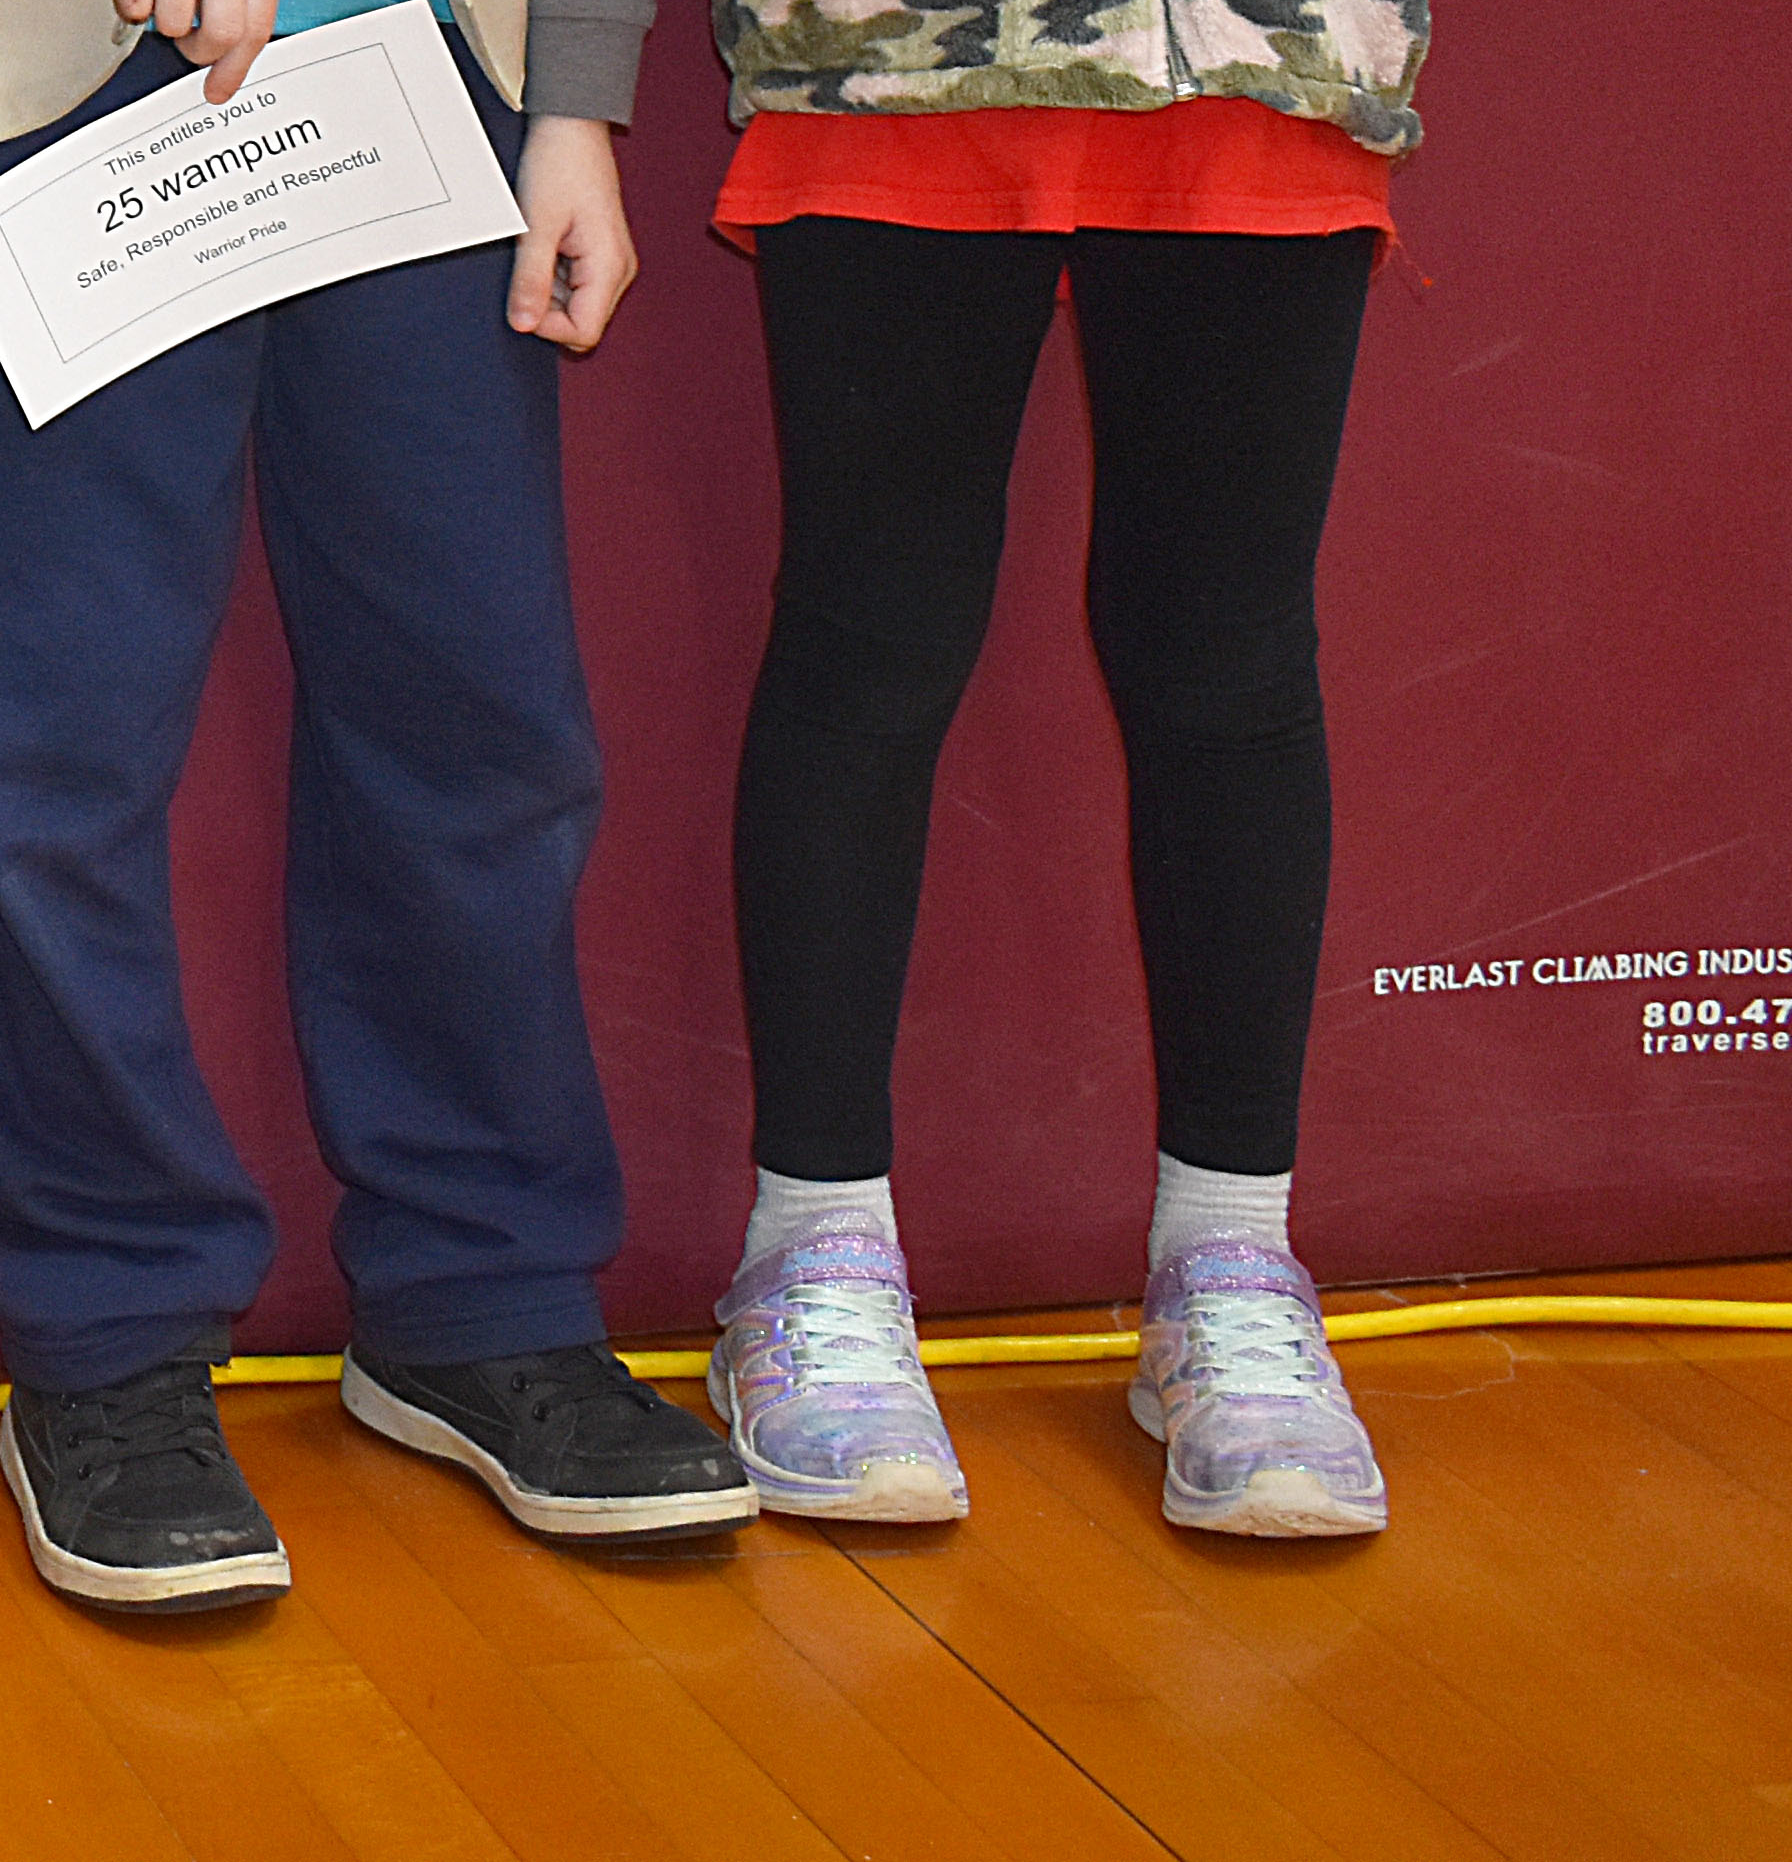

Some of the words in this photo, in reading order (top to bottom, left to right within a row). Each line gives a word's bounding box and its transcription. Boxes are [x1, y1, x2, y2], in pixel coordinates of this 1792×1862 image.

[104, 149, 147, 178] This
[149, 113, 215, 158] entitles
[217, 99, 255, 128] you
[257, 89, 277, 108] to
[96, 186, 145, 234] 25
[151, 118, 322, 203] wampum
[76, 255, 126, 290] Safe,
[126, 200, 239, 261] Responsible
[244, 178, 279, 206] and
[282, 146, 383, 192] Respectful
[193, 235, 246, 265] Warrior
[248, 218, 288, 247] Pride
[1373, 959, 1525, 995] EVERLAST
[1532, 951, 1690, 984] CLIMBING
[1642, 1031, 1791, 1055] traverse
